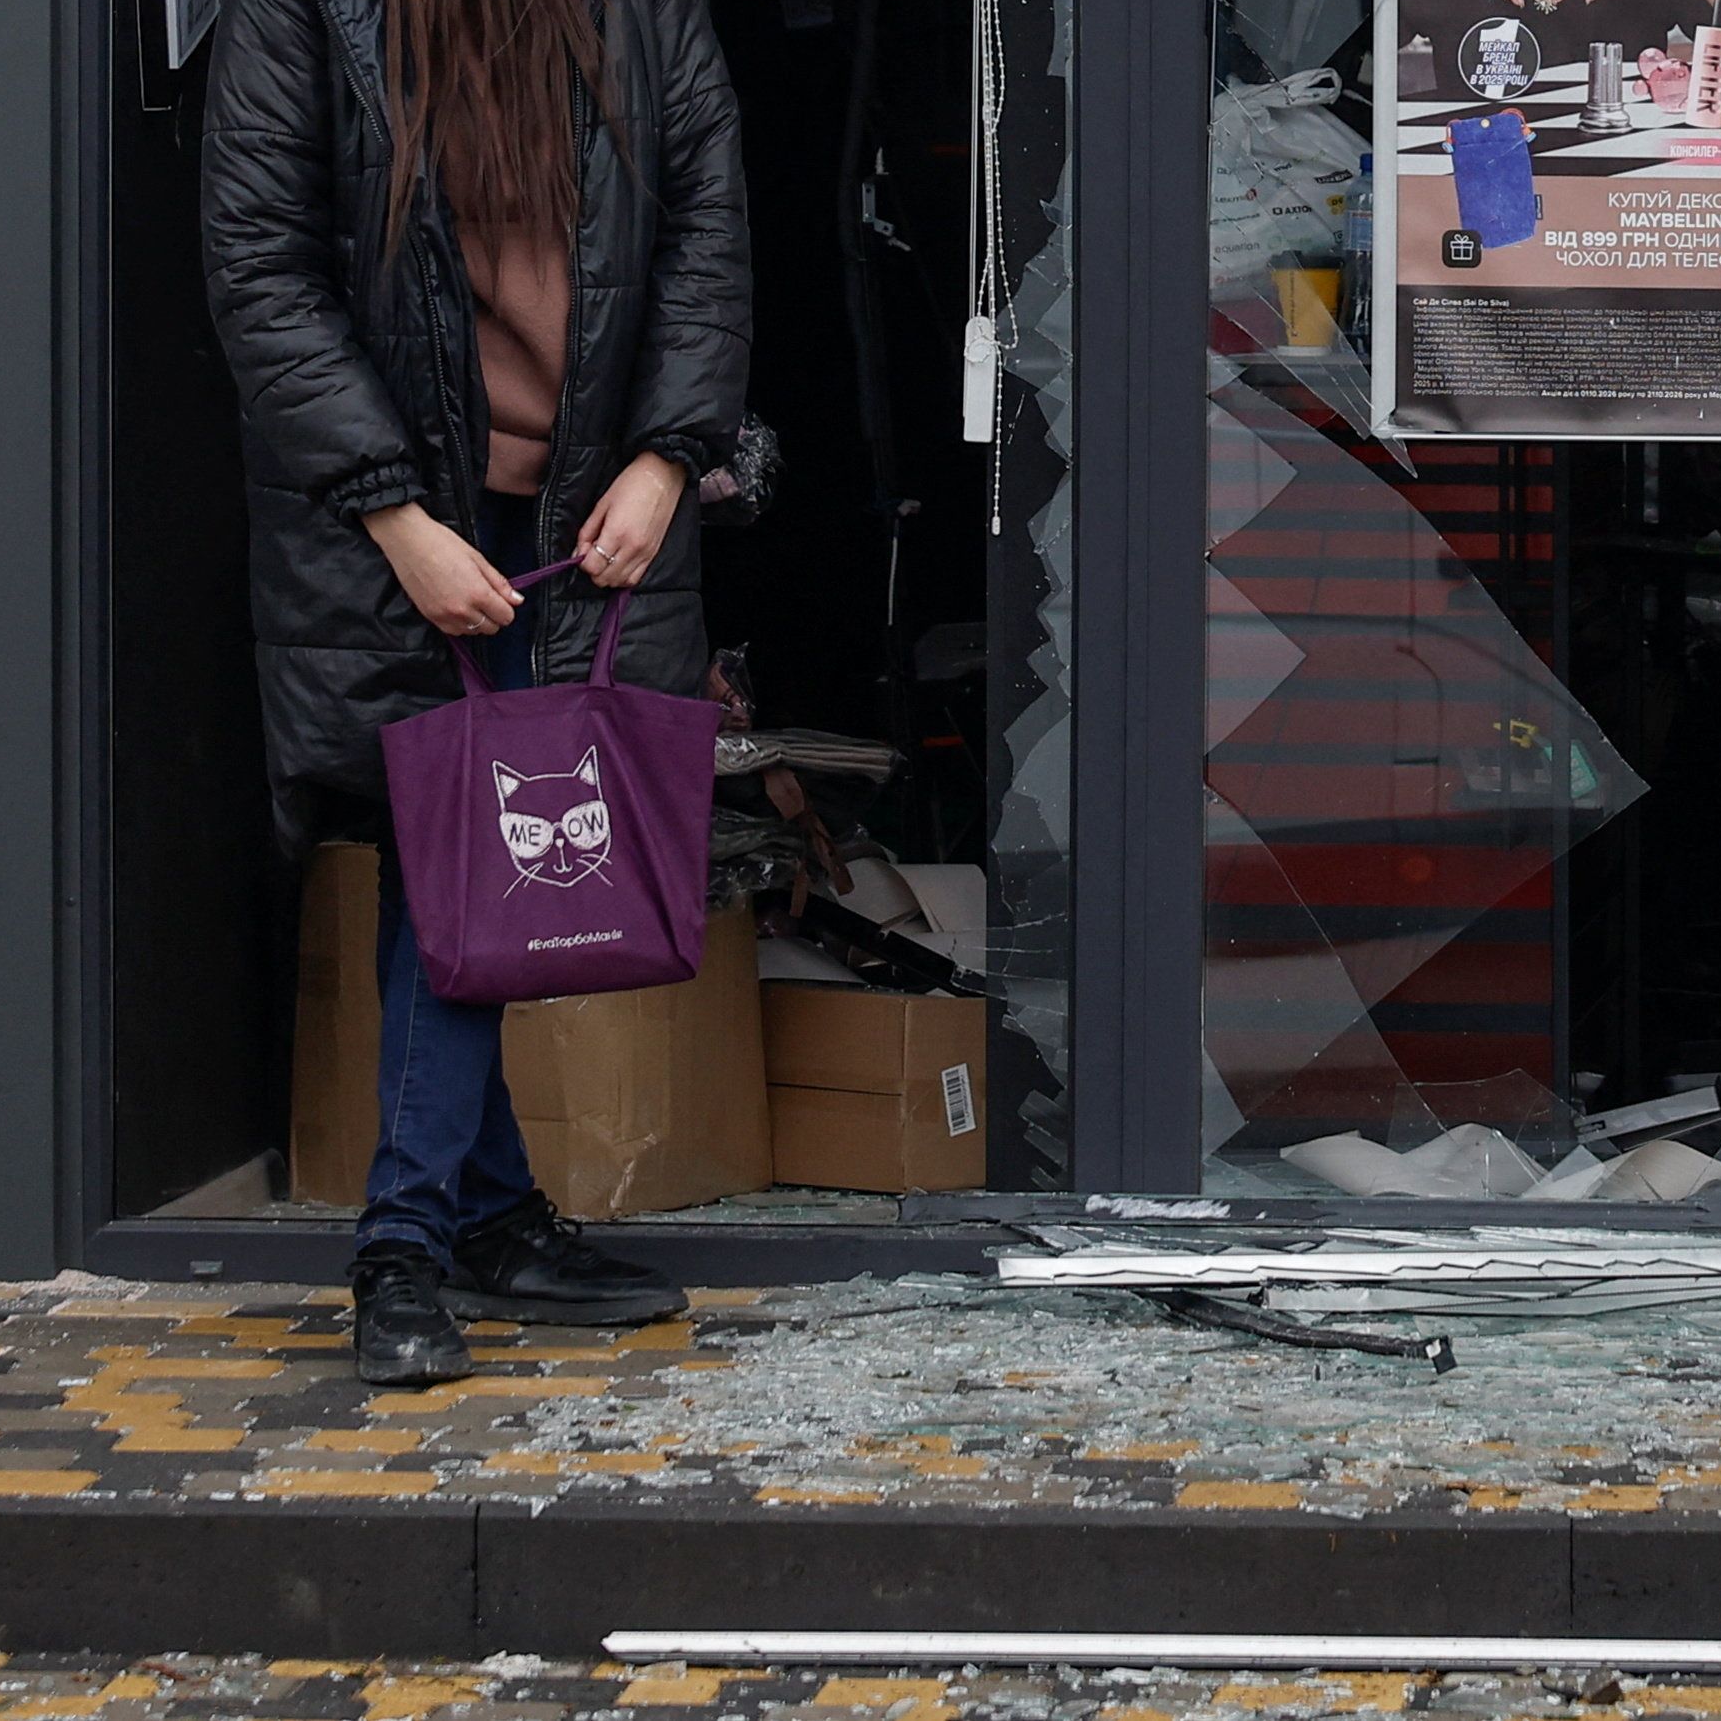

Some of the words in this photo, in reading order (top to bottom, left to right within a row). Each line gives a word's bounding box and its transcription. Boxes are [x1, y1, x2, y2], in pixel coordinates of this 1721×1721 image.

[1479, 39, 1520, 53] МЕЙКАП
[1482, 53, 1516, 64] БРЕНД
[1476, 64, 1484, 74] В
[1470, 75, 1478, 85] В
[1478, 75, 1504, 85] 2025
[1504, 75, 1528, 86] РОЦІ
[1608, 190, 1672, 208] КУПУЙ
[1544, 231, 1578, 248] ВІД
[1581, 232, 1618, 247] 899
[1622, 233, 1659, 247] ГРН
[1556, 251, 1622, 267] ЧОХОЛ
[1626, 252, 1667, 269] ДЛЯ
